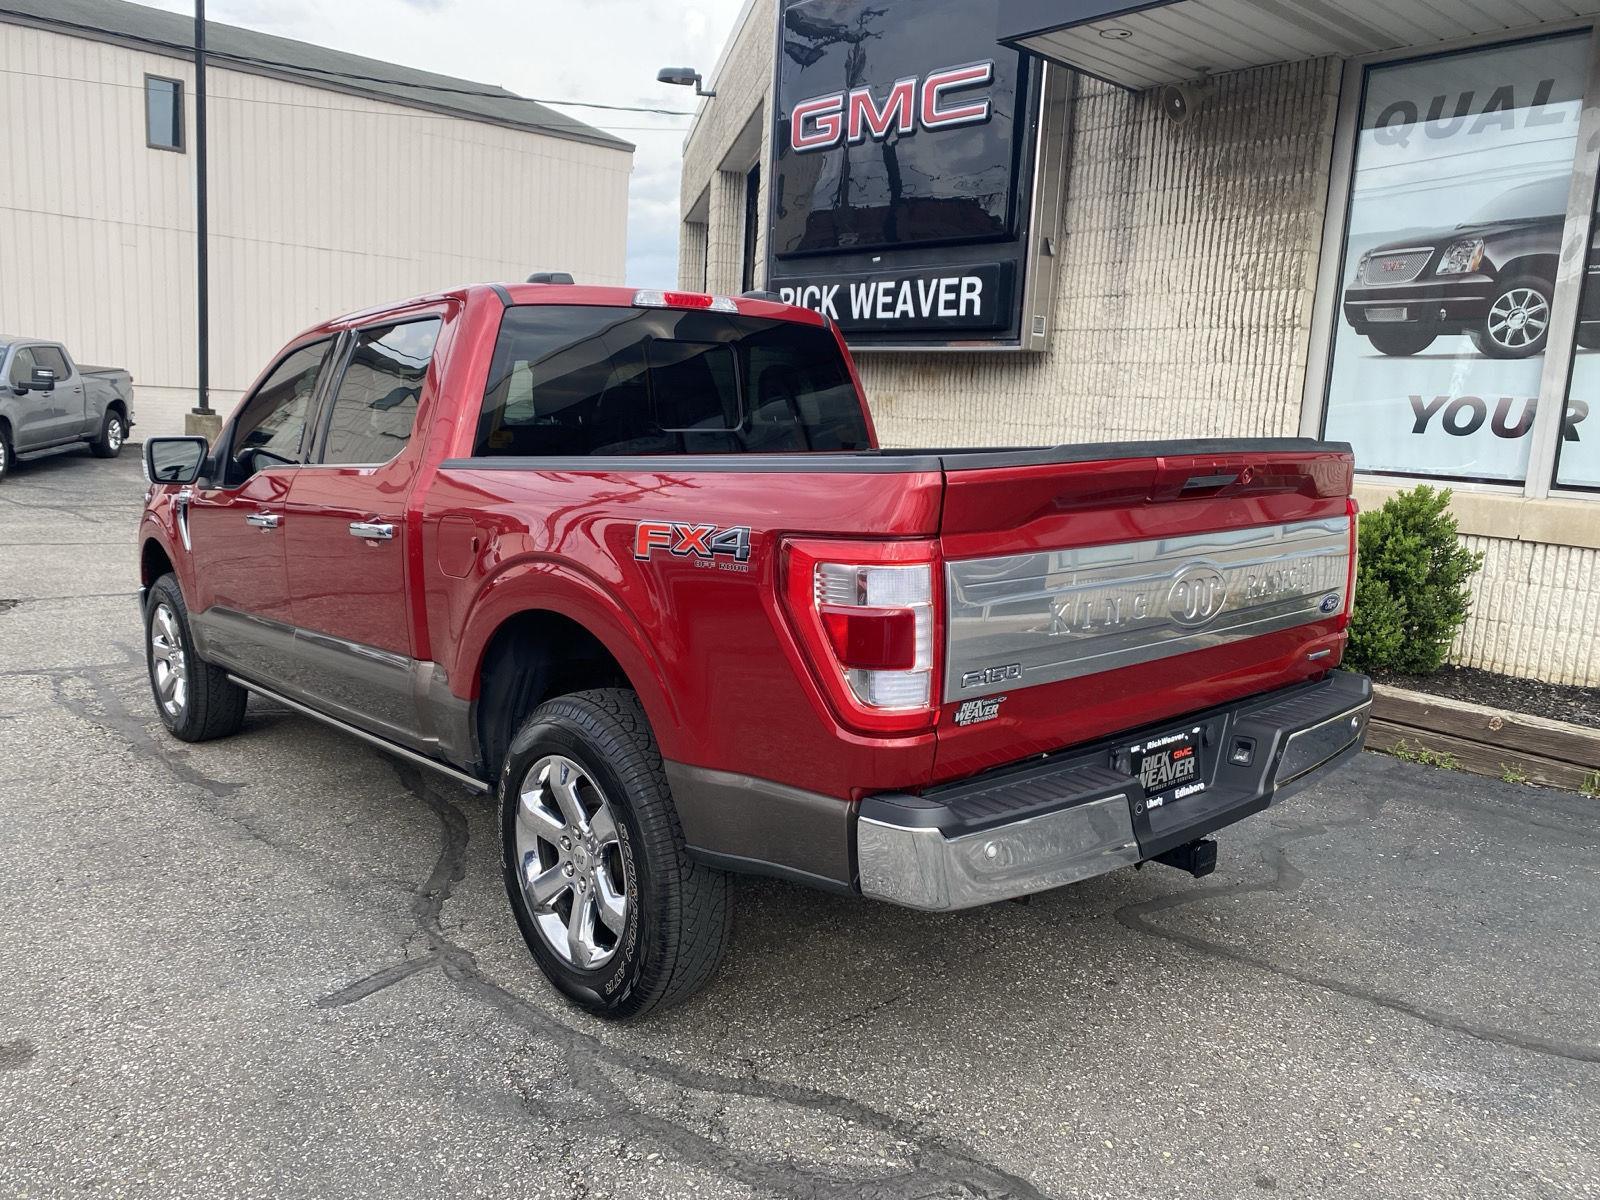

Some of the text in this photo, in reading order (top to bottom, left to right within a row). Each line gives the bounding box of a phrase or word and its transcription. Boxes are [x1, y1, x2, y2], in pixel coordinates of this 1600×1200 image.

[791, 60, 993, 153] GMC
[780, 276, 983, 320] RICK WEAVER
[634, 520, 751, 563] FX4
[694, 560, 749, 572] OFF ROAD
[1048, 561, 1314, 636] KING RANCH
[961, 663, 1021, 689] F-150
[955, 704, 999, 722] WEAVER
[961, 699, 983, 712] RICK
[1134, 757, 1195, 789] WEAVER
[1141, 747, 1193, 773] RICK GMC
[1175, 782, 1205, 799] Edinboro
